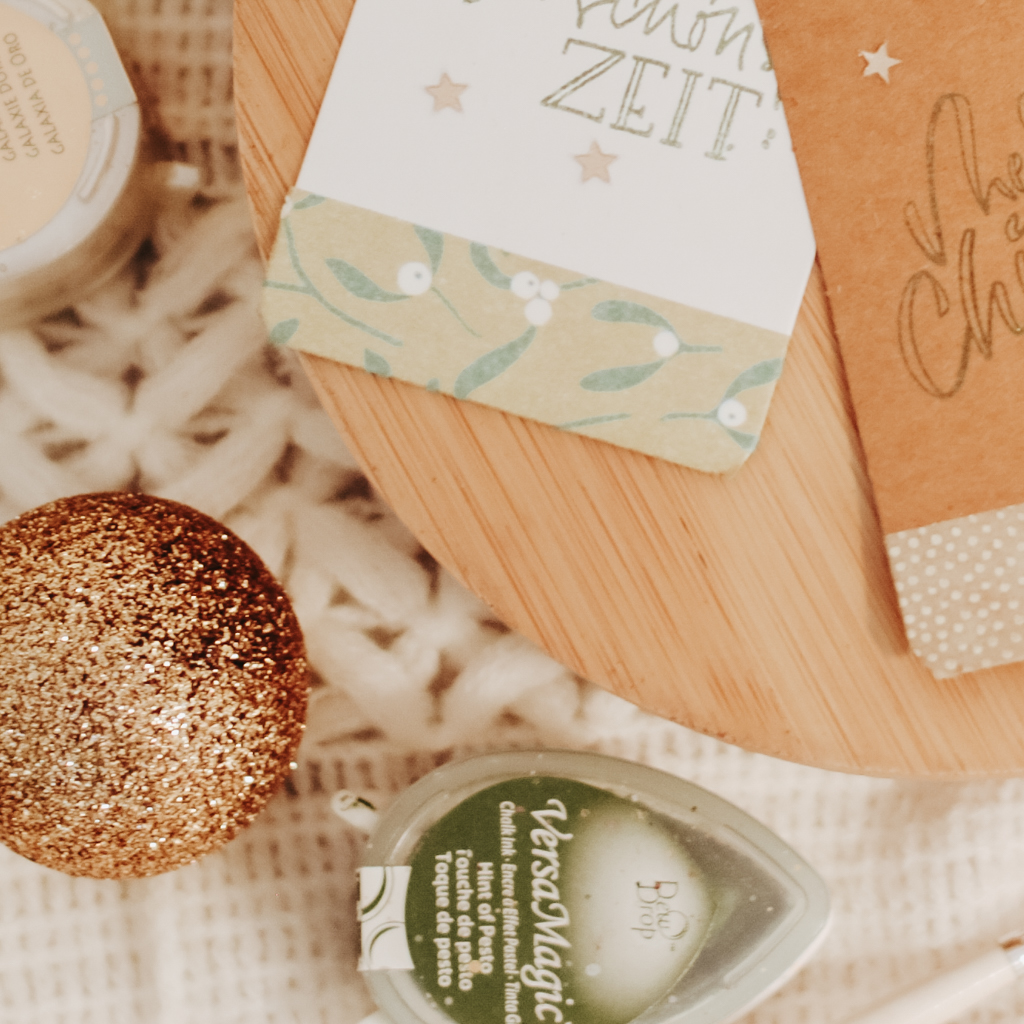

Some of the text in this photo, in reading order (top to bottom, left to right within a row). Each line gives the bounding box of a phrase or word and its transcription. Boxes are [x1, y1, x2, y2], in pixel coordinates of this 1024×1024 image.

[3, 32, 27, 66] ORO
[17, 67, 37, 88] DE
[3, 95, 40, 158] GALAXIE
[28, 89, 66, 155] GALAXIA
[499, 800, 517, 836] Chalk
[500, 837, 518, 857] Ink
[431, 850, 455, 988] Toque de pesto
[457, 914, 476, 938] de
[475, 862, 497, 975] Hint of Pesto
